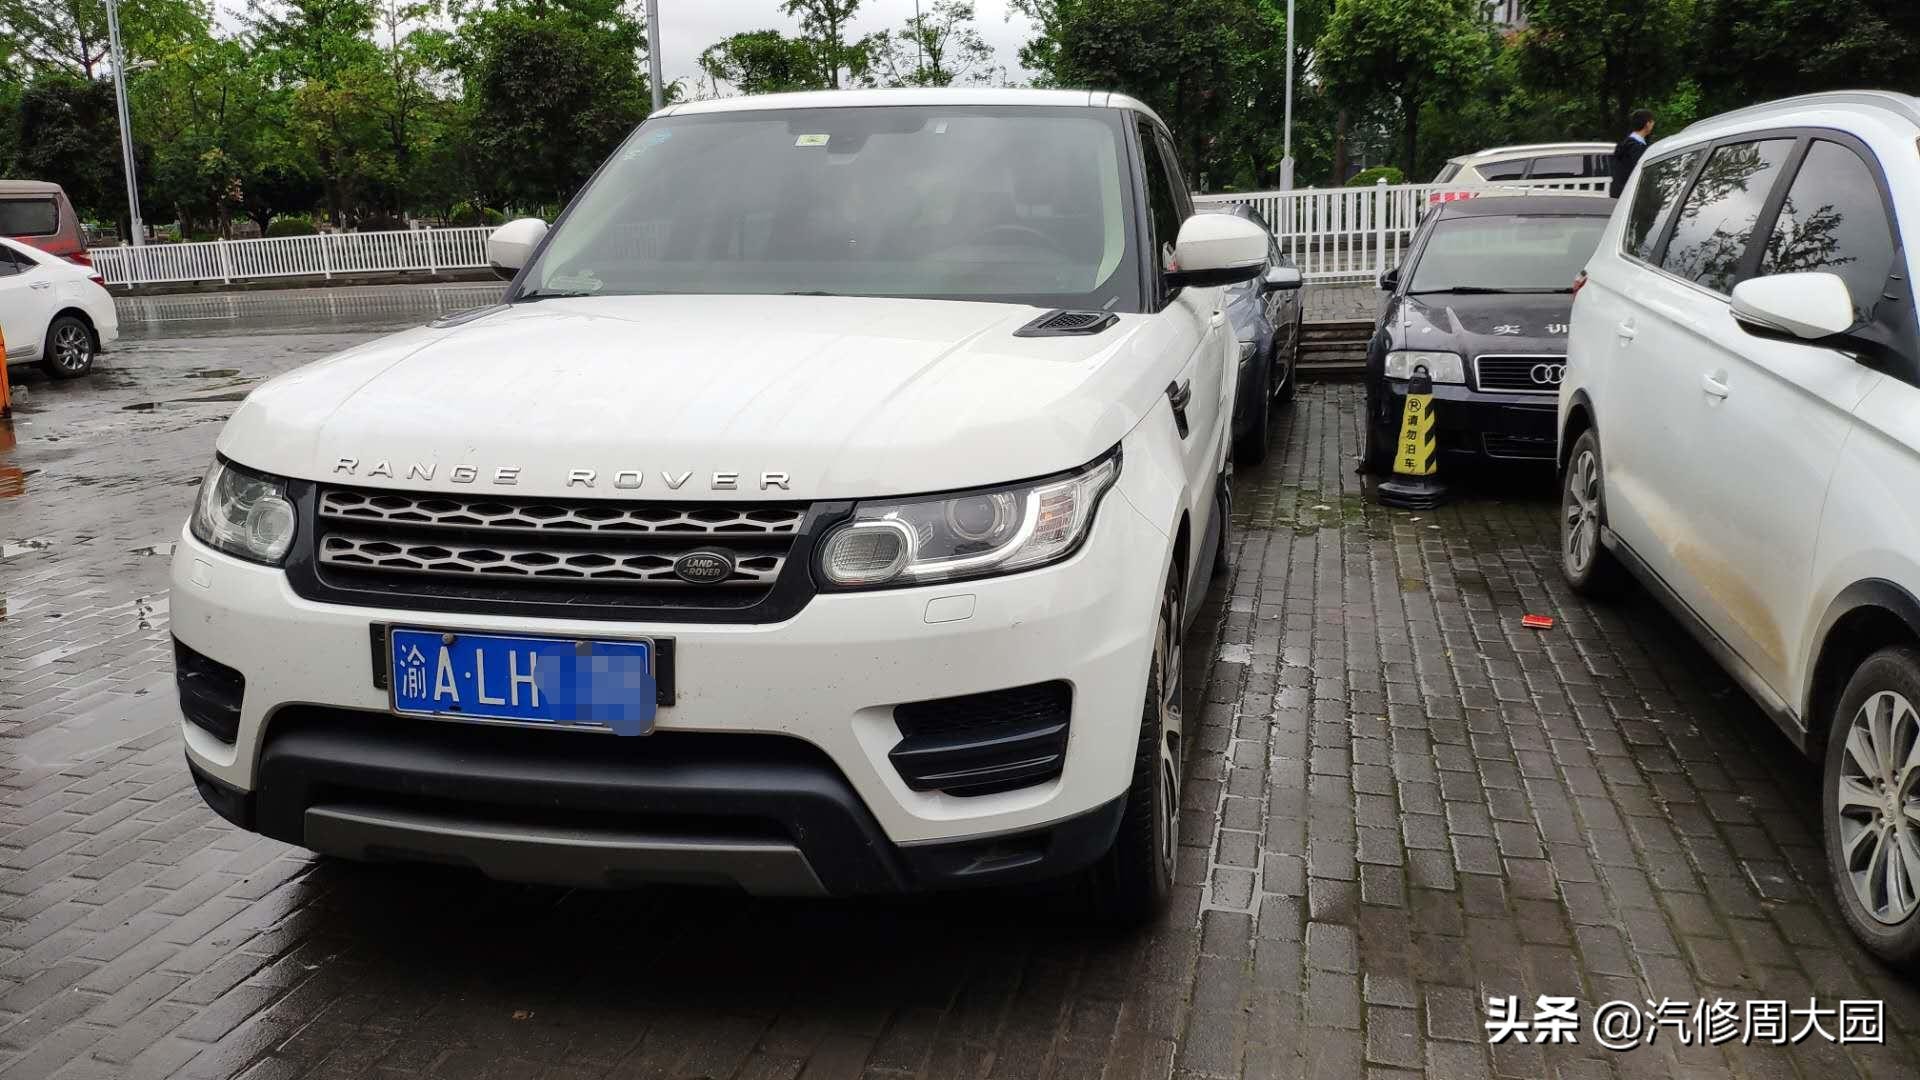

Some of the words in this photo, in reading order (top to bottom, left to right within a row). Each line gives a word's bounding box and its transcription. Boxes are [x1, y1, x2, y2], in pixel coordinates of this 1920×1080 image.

[1405, 415, 1418, 468] 请勿泊车
[333, 457, 522, 485] RANGE
[567, 470, 793, 491] ROVER
